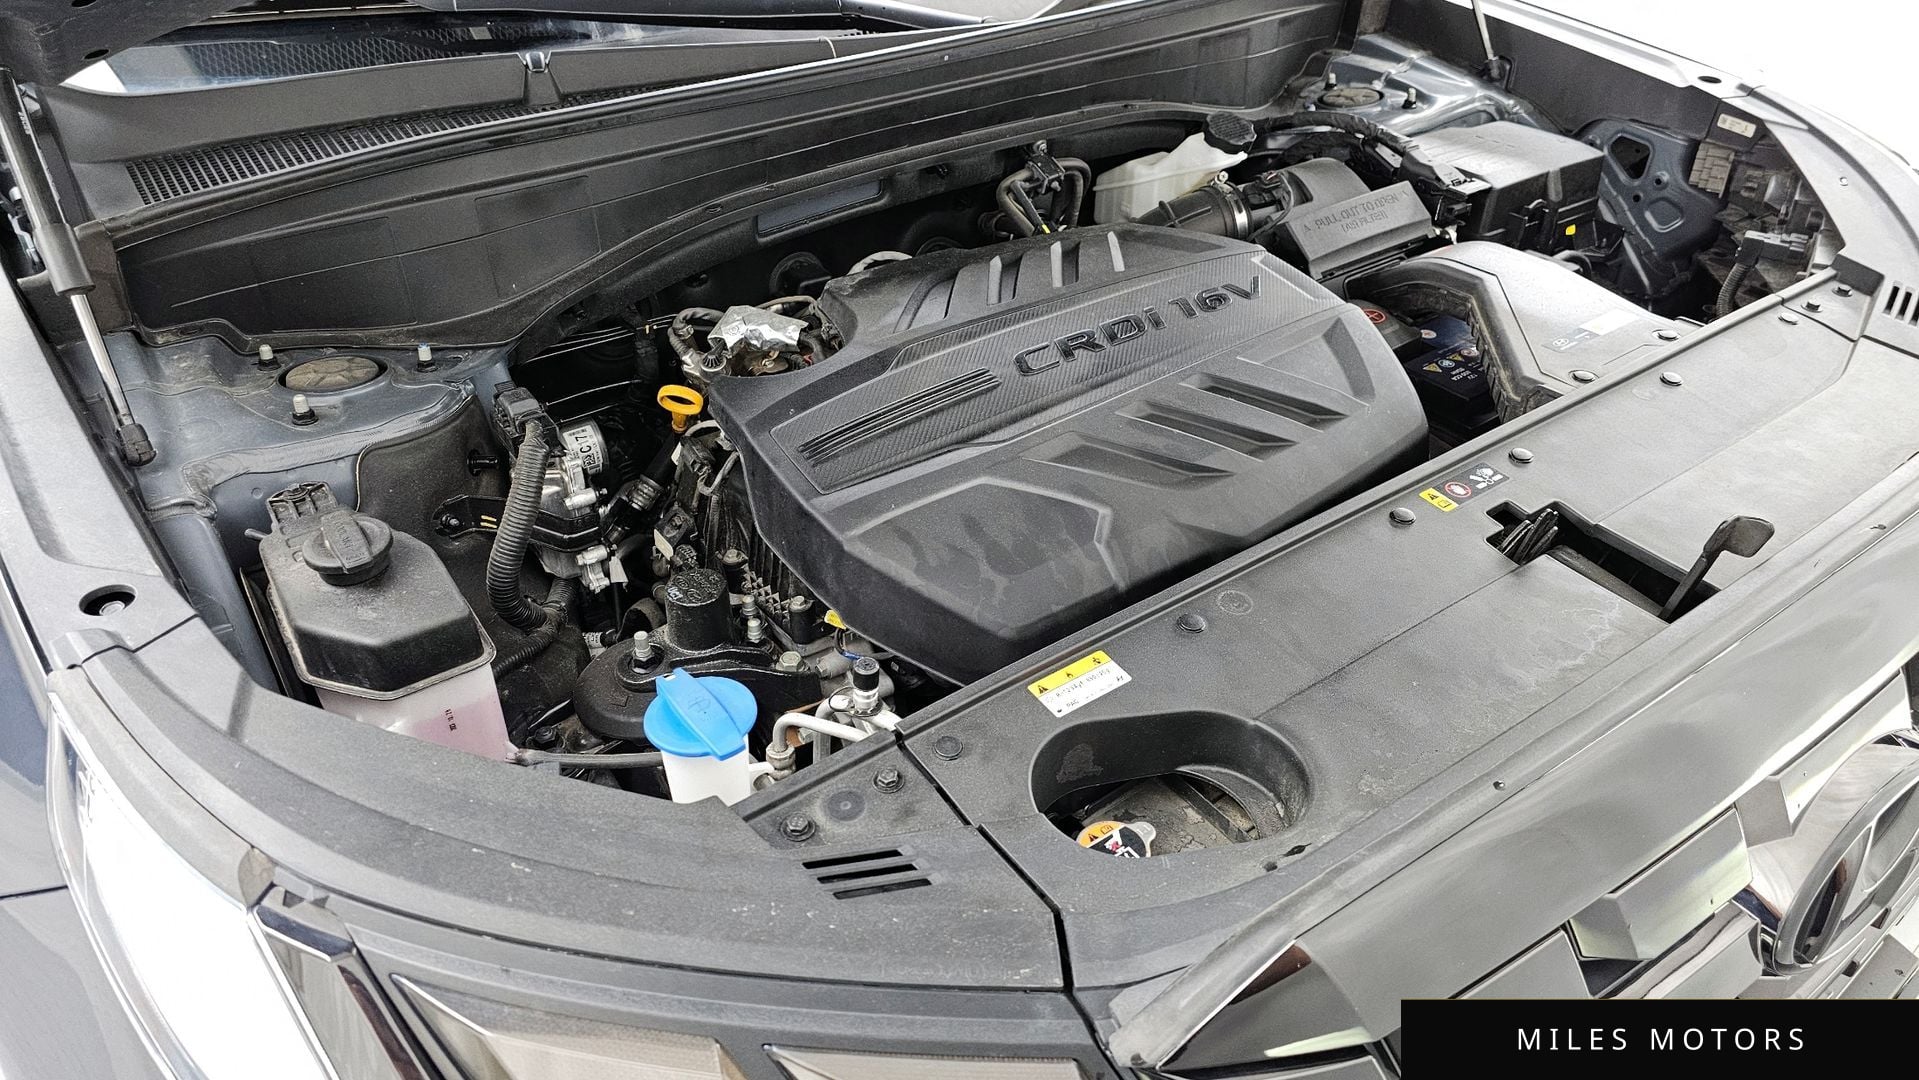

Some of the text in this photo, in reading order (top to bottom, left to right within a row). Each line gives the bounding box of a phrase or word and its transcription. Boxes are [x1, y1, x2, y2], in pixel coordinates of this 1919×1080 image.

[1314, 213, 1341, 230] PULL
[1340, 205, 1360, 220] OUT
[1361, 200, 1375, 213] TO
[1013, 274, 1261, 377] CRDi 16V
